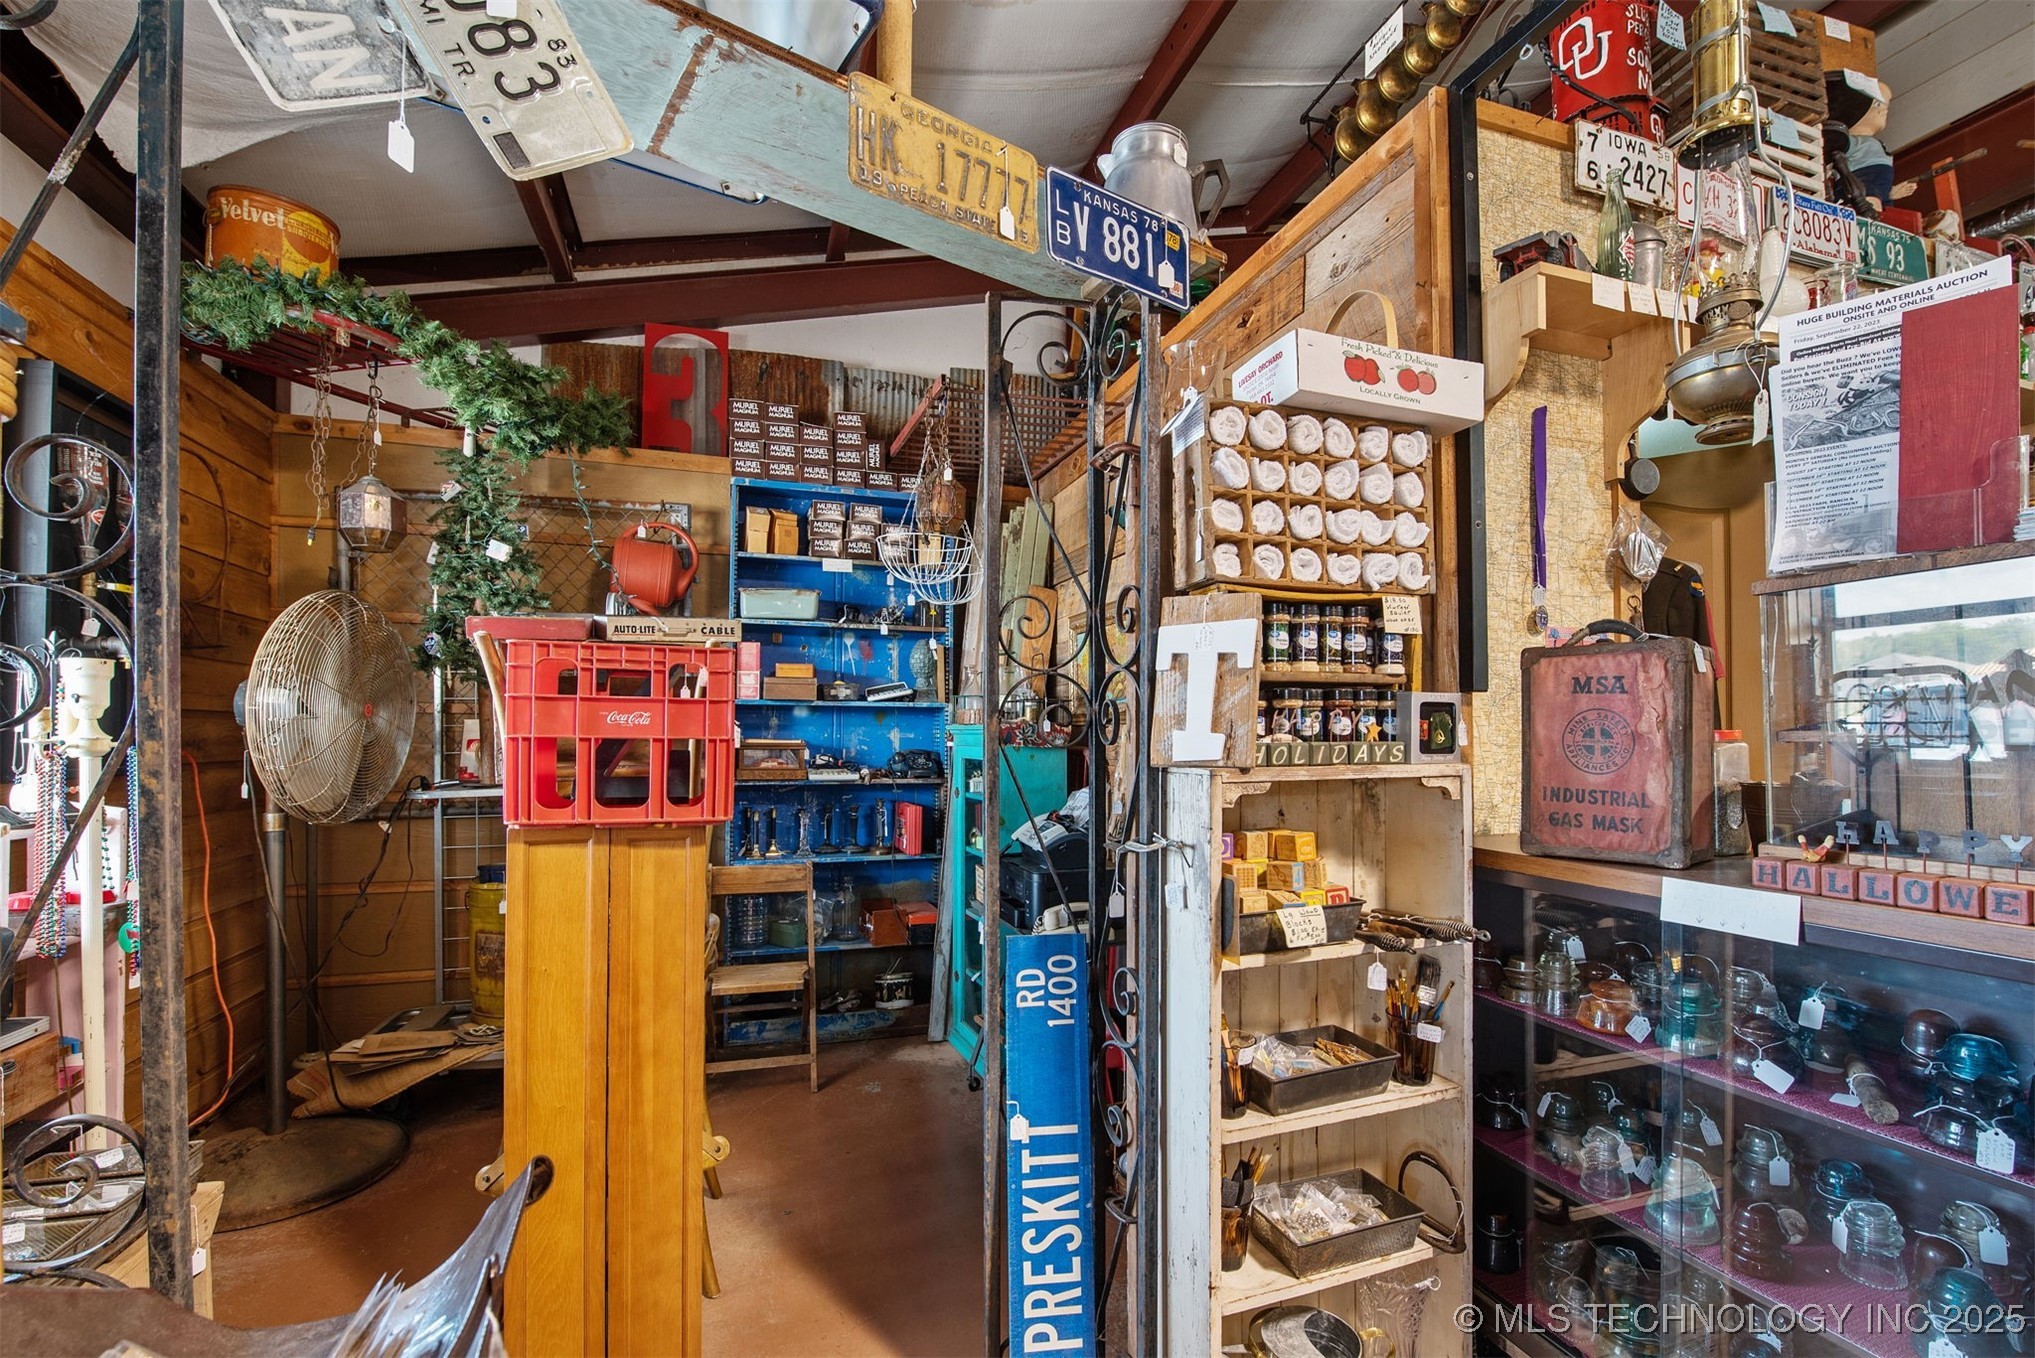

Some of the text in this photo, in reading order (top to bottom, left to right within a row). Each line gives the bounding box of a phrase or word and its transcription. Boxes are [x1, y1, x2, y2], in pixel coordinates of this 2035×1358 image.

[547, 38, 577, 71] 83
[1558, 16, 1612, 80] OU
[443, 42, 478, 88] TR.
[900, 101, 994, 156] GEORGIA
[856, 105, 900, 176] HK
[1587, 131, 1598, 152] 7
[1608, 132, 1647, 158] IOWA
[1587, 160, 1599, 180] 6
[1620, 156, 1668, 198] 2427
[899, 183, 949, 214] PEACH
[220, 196, 287, 230] Velvet
[1083, 189, 1159, 233] KANSAS 78
[1870, 225, 1900, 241] KANSAS
[1102, 216, 1155, 279] 881
[1797, 239, 1839, 259] Alabama
[1885, 241, 1905, 273] 93
[1796, 269, 1989, 327] HUGE BUILDING MATERIALS AUCTION
[1842, 294, 1936, 324] ONSITE AND ONLINE
[1815, 327, 1851, 339] September
[1863, 319, 1880, 328] 2023
[1341, 337, 1439, 369] Fresh Picked & Delicious
[1806, 361, 1822, 370] hear
[1823, 358, 1835, 366] the
[1836, 356, 1852, 364] Buzz
[1832, 358, 1876, 371] ELIMINATED
[1877, 355, 1894, 363] Fees
[1237, 369, 1257, 388] LIVESAY
[1257, 350, 1284, 374] ORCHARD
[1840, 369, 1859, 377] want
[1859, 366, 1873, 374] you
[732, 401, 759, 410] MURIEL
[1786, 387, 1828, 403] CONSIGN
[1789, 400, 1819, 412] TODAY
[733, 408, 759, 416] MAGNUM
[837, 414, 861, 422] MURIEL
[769, 425, 795, 434] MURIEL
[836, 433, 861, 441] MURIEL
[769, 444, 795, 453] MURIEL
[836, 451, 861, 459] MURIEL
[1833, 446, 1870, 456] CONSIGNMENT
[735, 459, 761, 468] MURIEL
[735, 466, 761, 474] MAGNUM
[803, 466, 829, 475] MURIEL
[854, 505, 879, 513] MURIEL
[701, 625, 736, 636] CABLE
[1571, 675, 1629, 695] MSA
[606, 710, 651, 726] Coca-Cola
[1567, 712, 1630, 737] MINE SAFETY
[1565, 743, 1620, 772] APPLIANCES
[1543, 786, 1651, 809] INDUSTRIAL
[1548, 812, 1644, 835] GAS MASK
[1834, 820, 2033, 863] HAPPY
[1016, 967, 1046, 1008] RD
[1047, 953, 1078, 1027] 1400
[1021, 1119, 1084, 1354] PRESKITT
